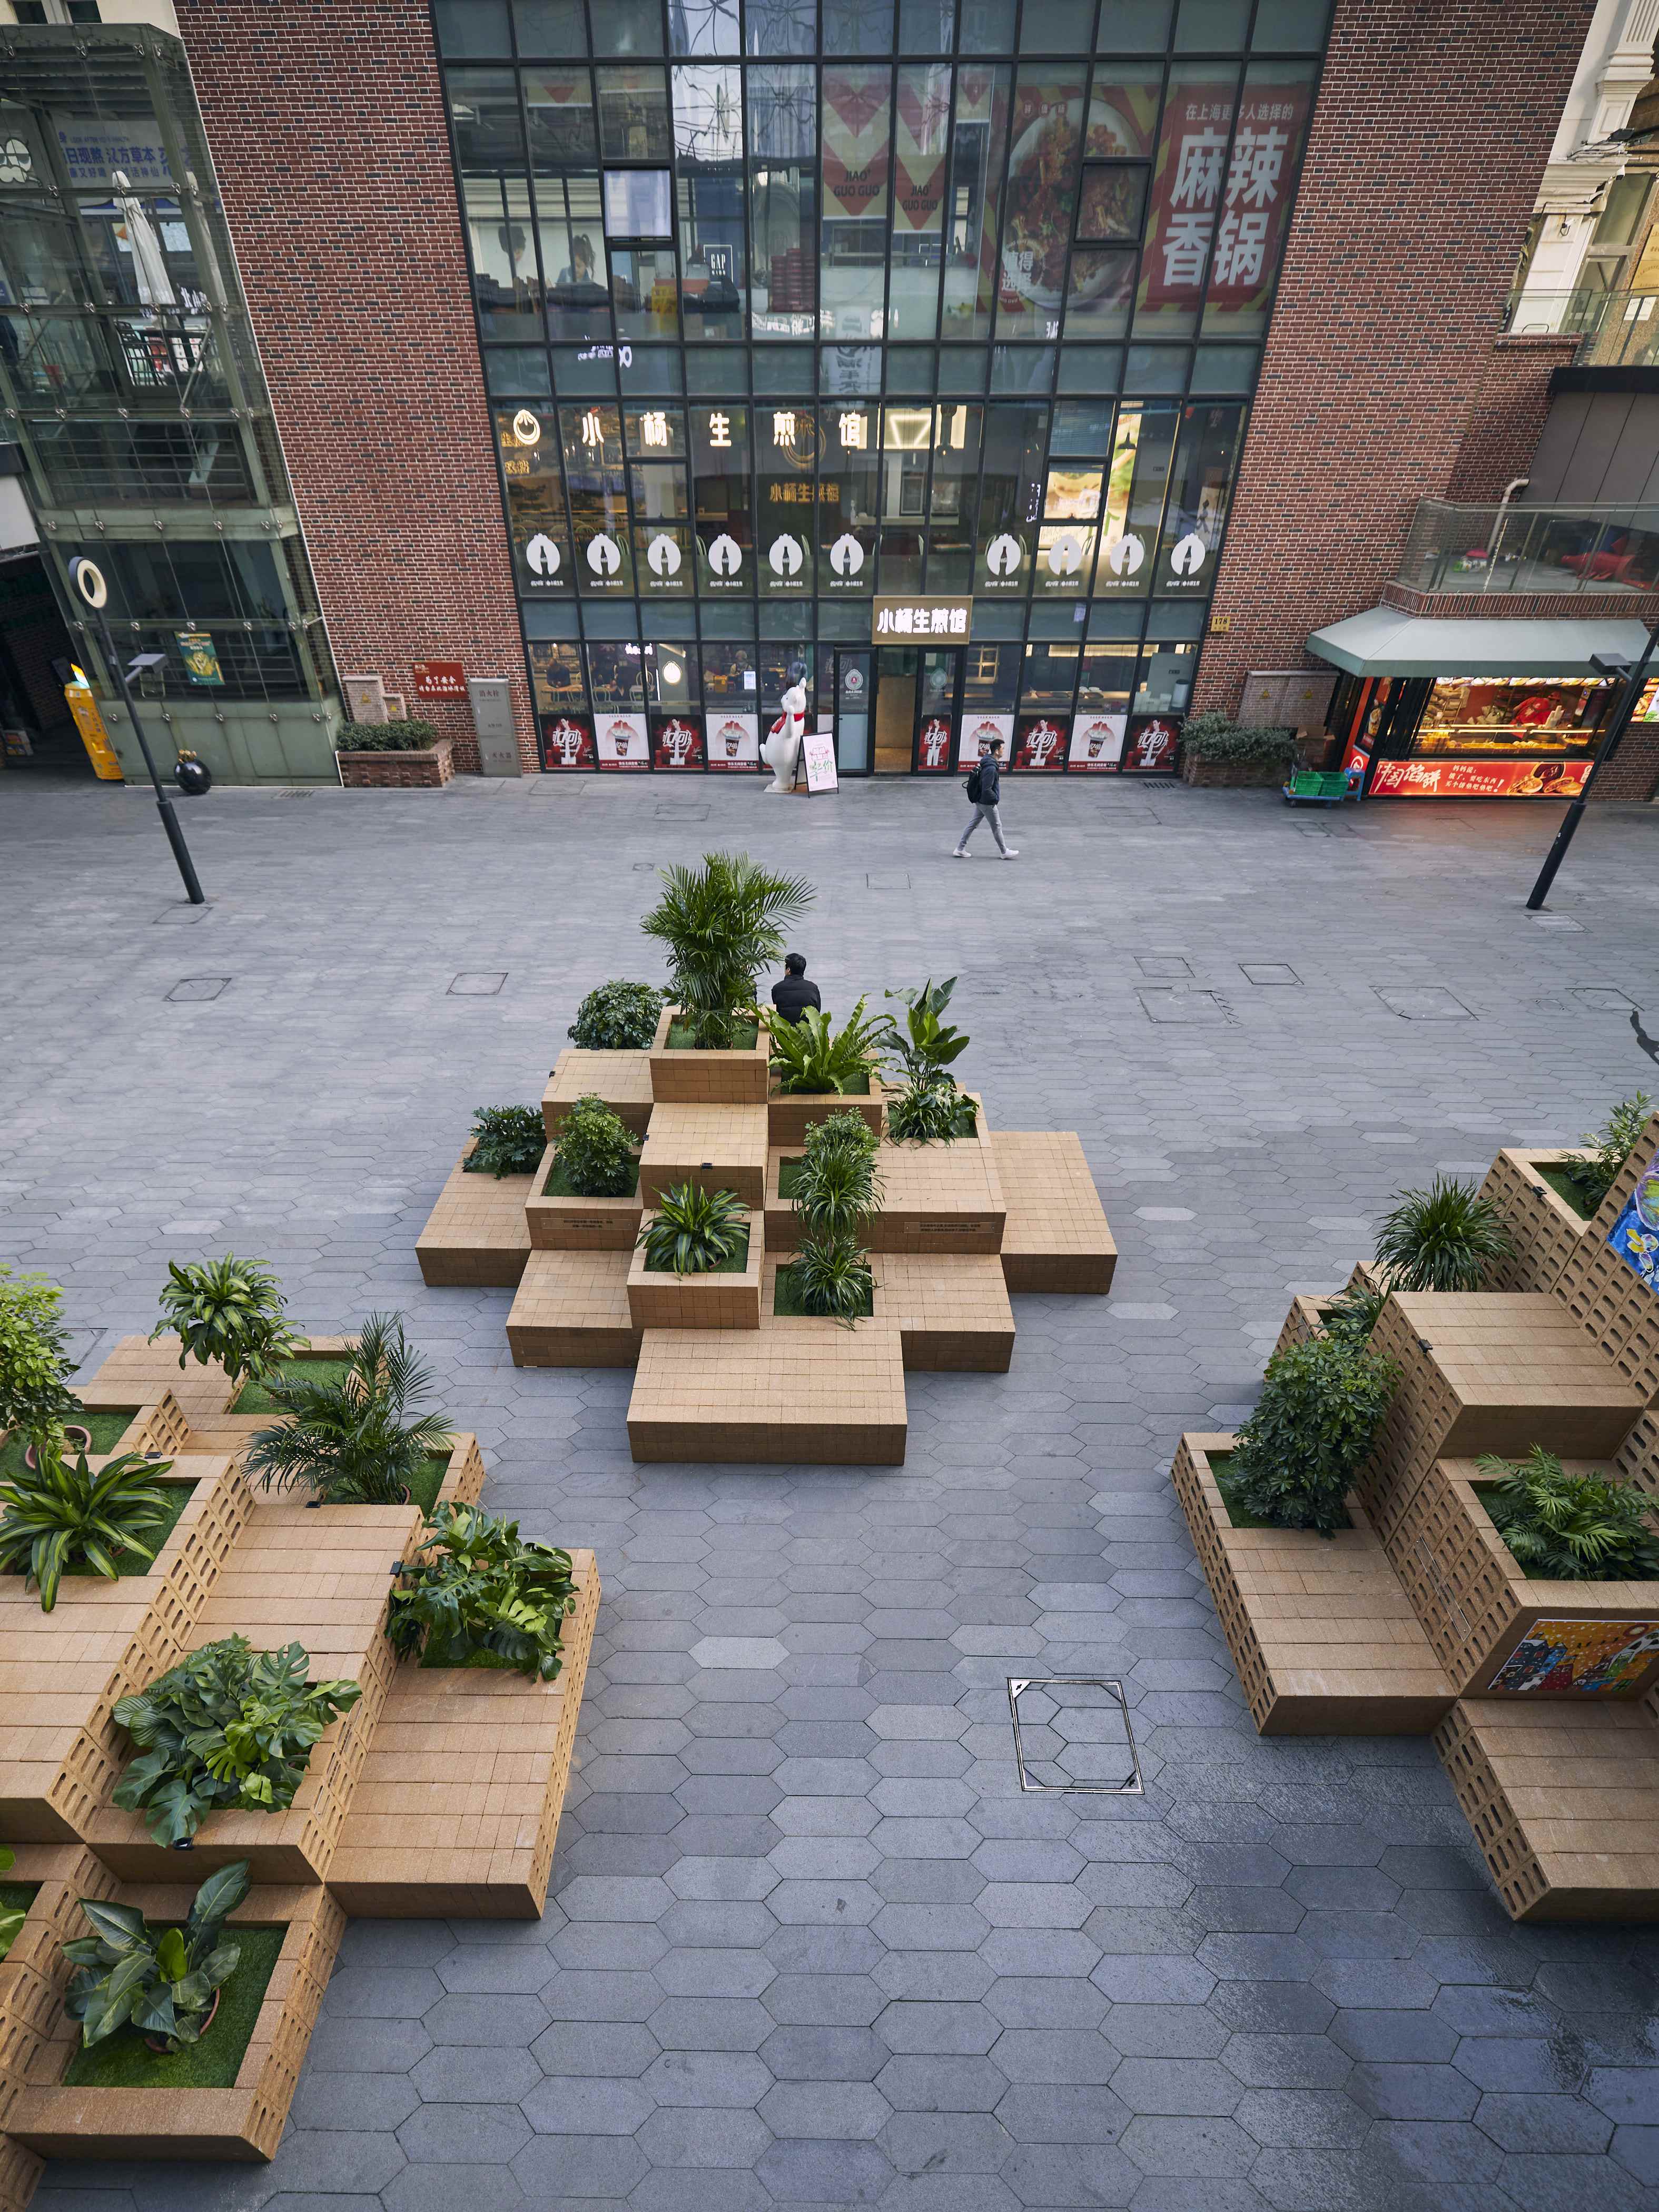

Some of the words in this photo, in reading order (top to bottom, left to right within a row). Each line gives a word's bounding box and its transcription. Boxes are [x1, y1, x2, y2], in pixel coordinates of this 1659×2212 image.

[1169, 126, 1289, 208] 麻辣
[833, 185, 856, 197] GUO
[858, 185, 881, 196] GUO
[902, 200, 919, 210] GUO
[921, 200, 938, 210] GUO
[710, 253, 726, 270] GAP
[1162, 210, 1270, 287] 香锅
[582, 410, 861, 447] 小杨生煎馆
[877, 608, 967, 634] 小杨生煎馆
[1374, 762, 1441, 793] 中国馅饼
